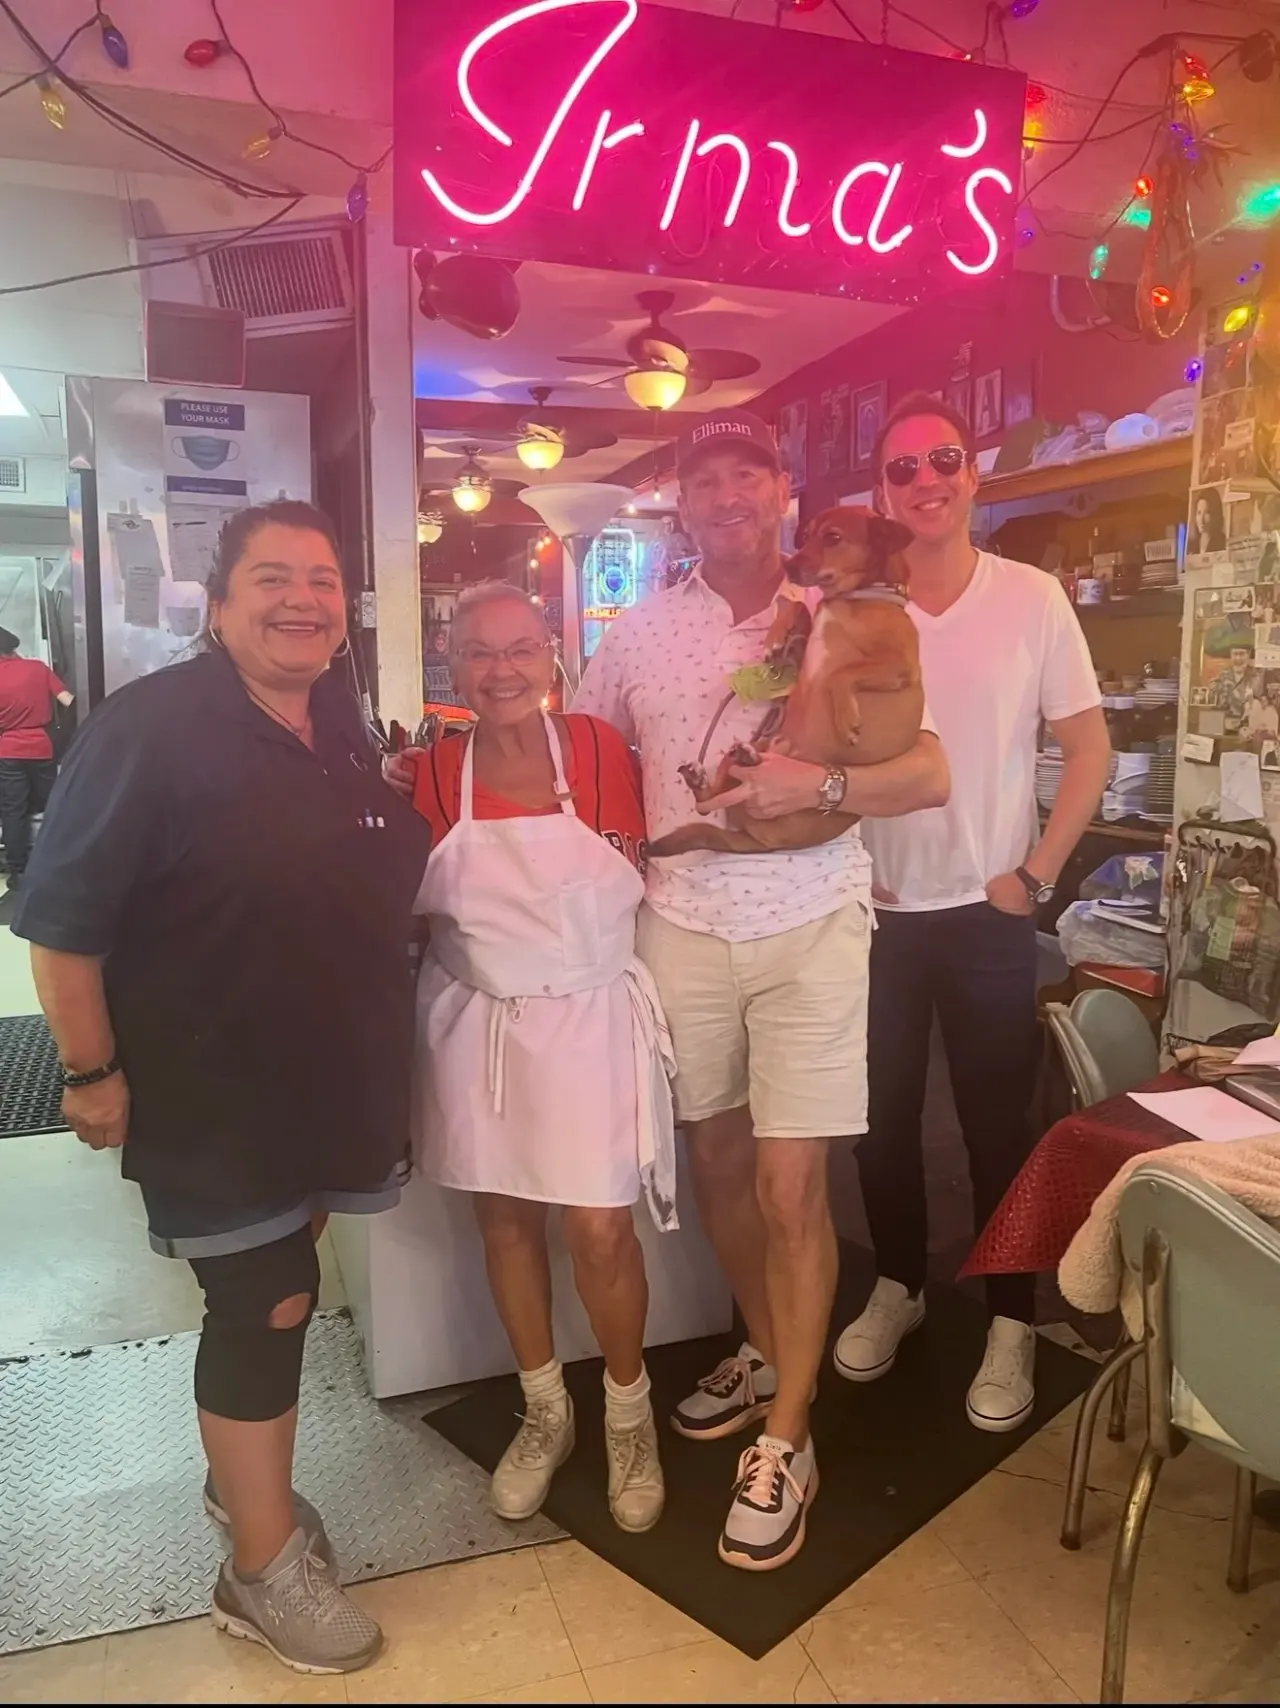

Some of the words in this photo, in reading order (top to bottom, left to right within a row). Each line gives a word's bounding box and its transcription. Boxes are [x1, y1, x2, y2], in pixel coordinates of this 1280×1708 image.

[421, 0, 1013, 275] Irma's
[180, 402, 211, 413] PLEASE
[212, 405, 228, 413] USE
[180, 413, 205, 423] YOUR
[205, 416, 230, 426] MASK
[692, 421, 752, 444] Elliman
